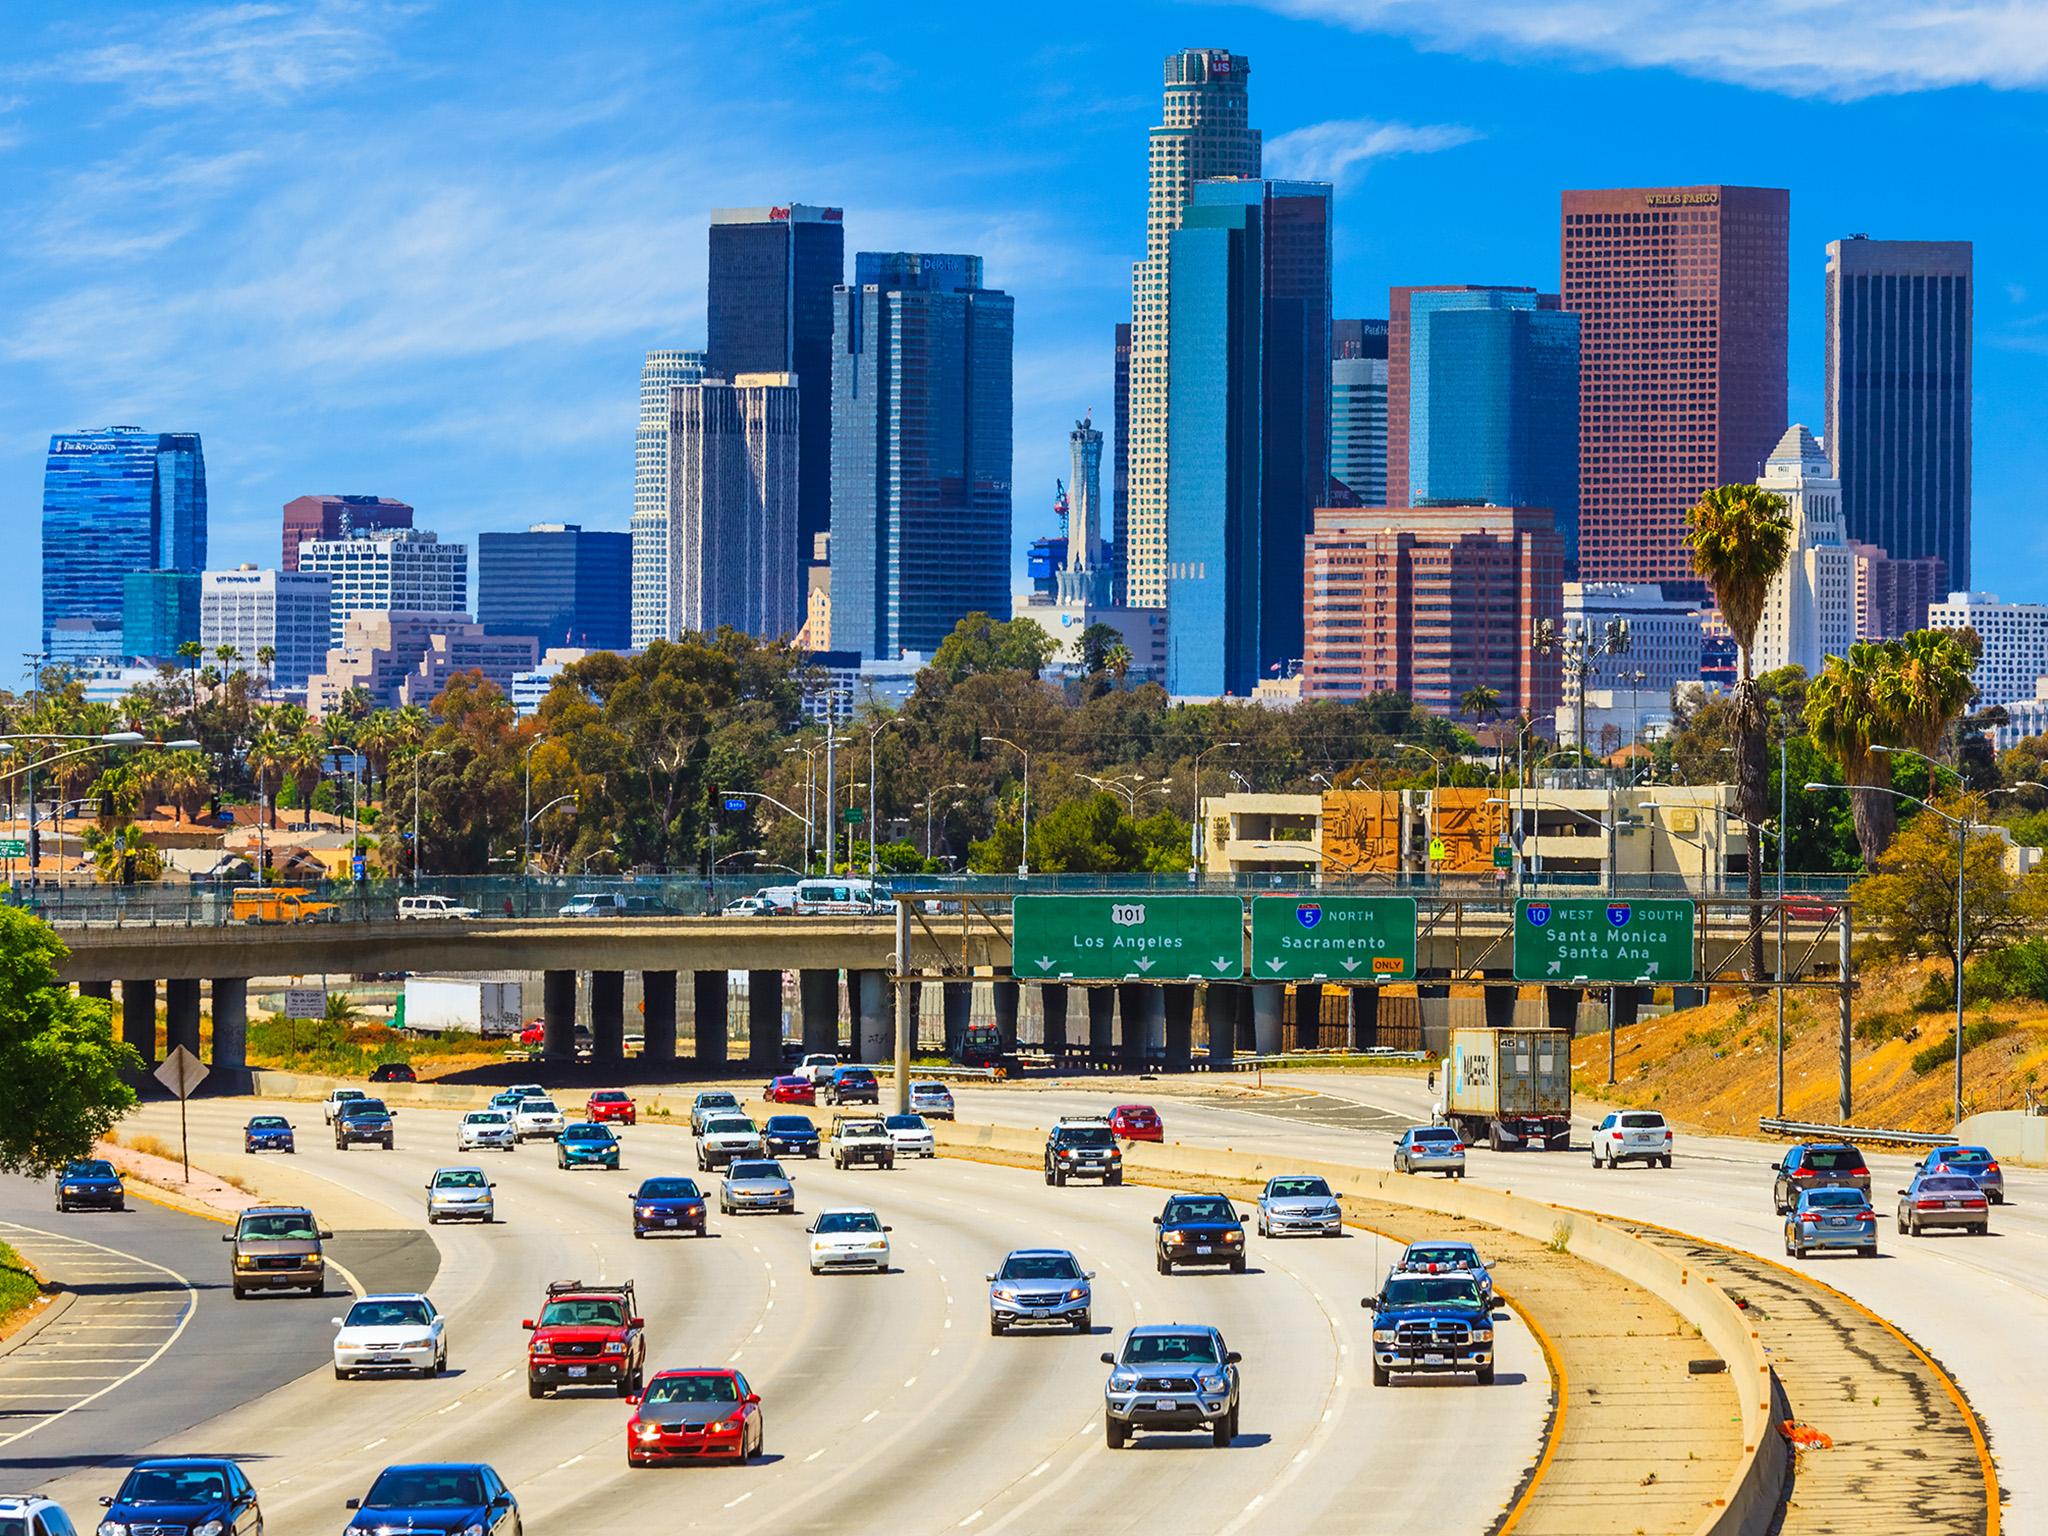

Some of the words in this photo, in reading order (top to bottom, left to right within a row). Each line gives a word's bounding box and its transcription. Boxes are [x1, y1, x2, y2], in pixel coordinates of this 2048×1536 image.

[1645, 193, 1681, 204] WELLS
[1682, 193, 1718, 203] FARGO
[395, 543, 414, 553] ONE
[419, 543, 465, 554] WILSHIRE
[1118, 909, 1140, 921] 101
[1305, 911, 1313, 923] 5
[1329, 911, 1374, 921] NORTH
[1532, 910, 1546, 922] 10
[1559, 910, 1593, 920] WEST
[1615, 910, 1623, 922] 5
[1638, 910, 1683, 921] SOUTH
[1546, 929, 1598, 942] Santa
[1607, 929, 1667, 943] Monica
[1073, 935, 1104, 948] Los
[1113, 935, 1183, 950] Angeles
[1282, 936, 1386, 949] Sacramento
[1558, 946, 1609, 959] Santa
[1617, 946, 1649, 959] Ana
[1374, 960, 1401, 969] ONLY
